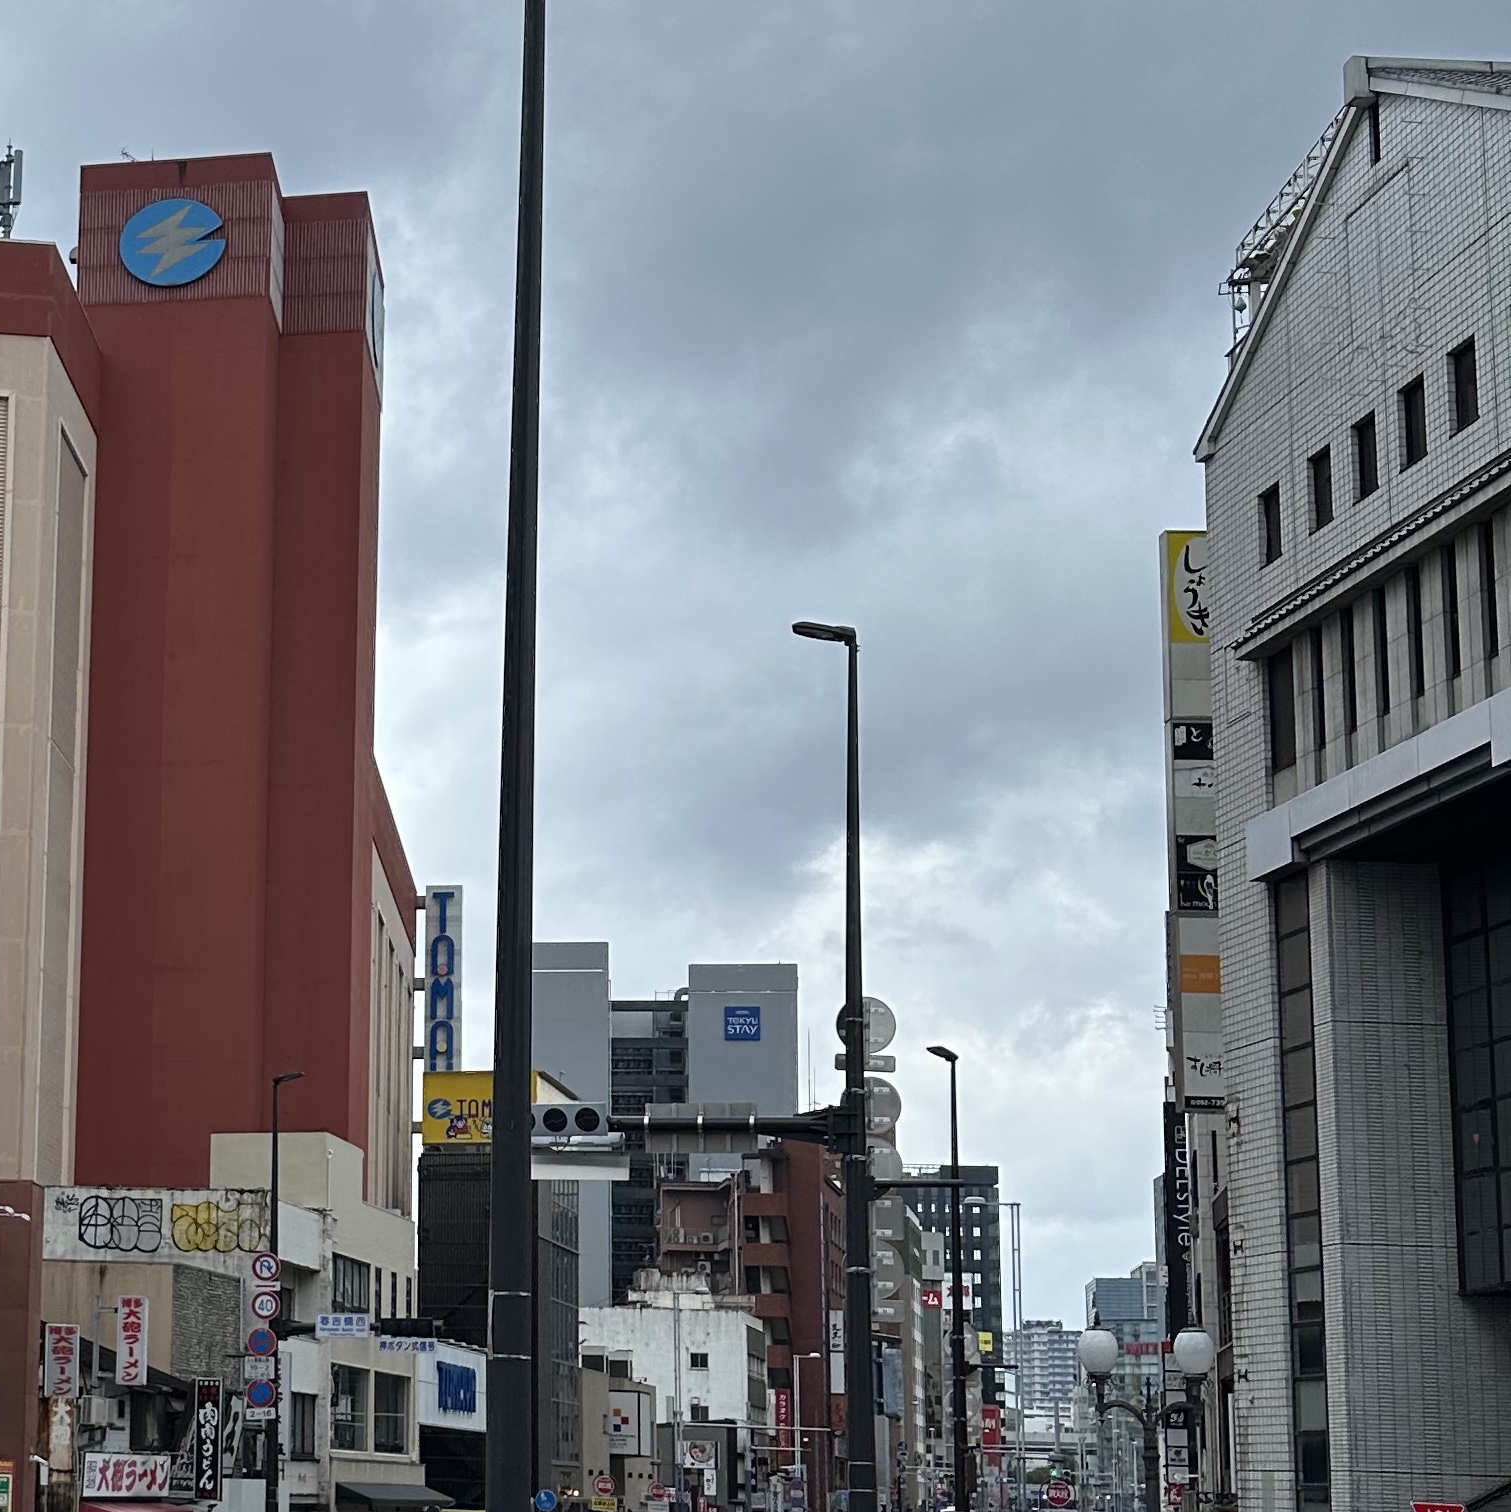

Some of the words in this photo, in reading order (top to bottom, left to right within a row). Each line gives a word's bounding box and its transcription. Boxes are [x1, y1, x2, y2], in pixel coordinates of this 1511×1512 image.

[430, 891, 455, 1071] TAMA
[727, 1017, 759, 1025] TOKYU
[727, 1025, 759, 1036] STAY
[457, 1099, 492, 1118] TAM
[257, 1299, 274, 1312] 40
[121, 1309, 142, 1382] 大砲ラーメン
[51, 1335, 74, 1395] 大砲ラーメン
[250, 1410, 272, 1418] 2-16
[198, 1401, 218, 1490] 肉肉うどん
